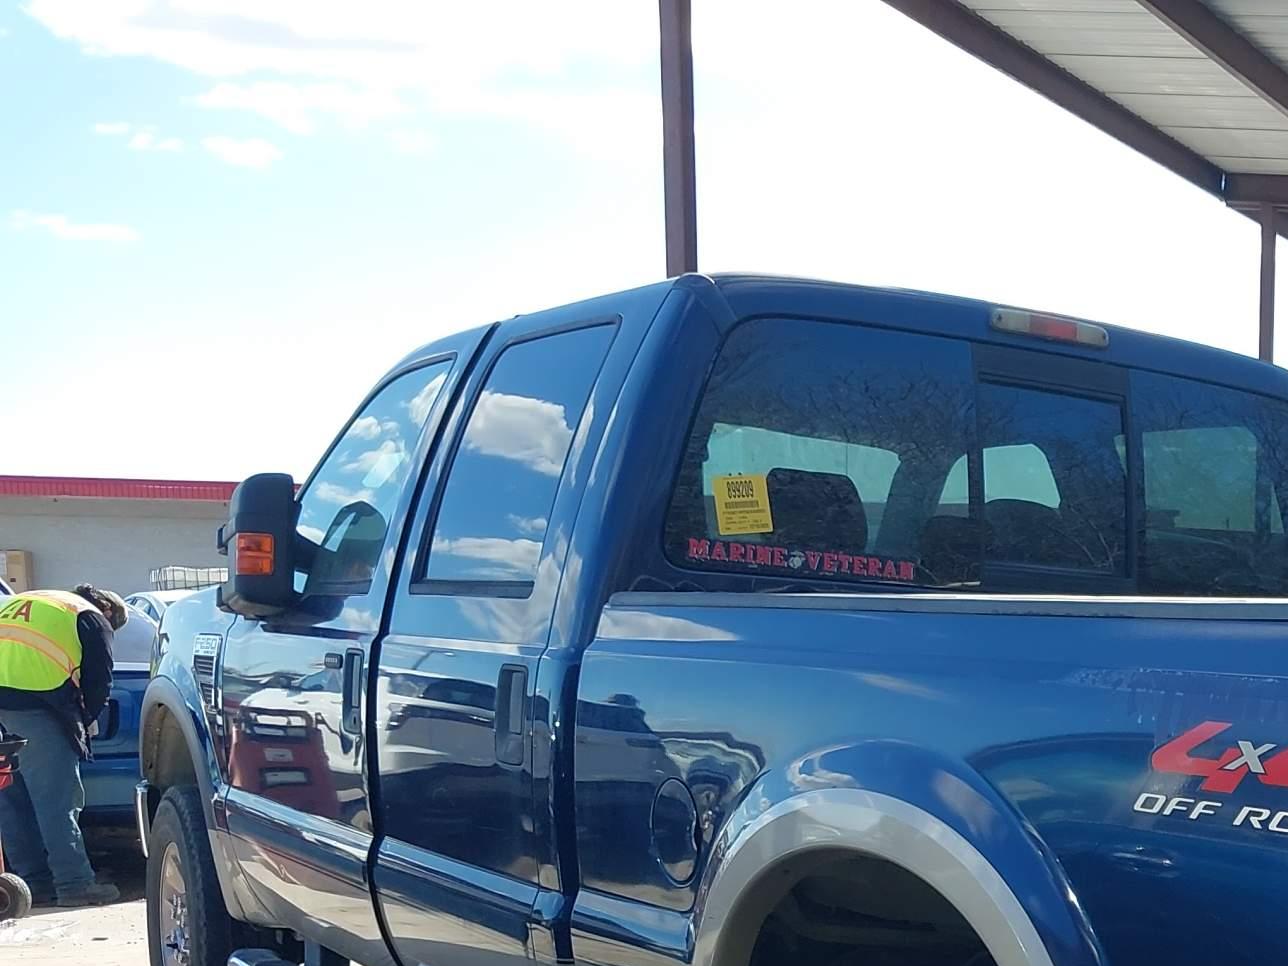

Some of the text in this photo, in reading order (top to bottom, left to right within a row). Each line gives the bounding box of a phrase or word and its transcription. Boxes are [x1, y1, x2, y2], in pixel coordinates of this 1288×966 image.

[727, 480, 754, 499] 899209
[688, 539, 914, 580] MARINE VETERAN
[1133, 793, 1222, 820] OFF
